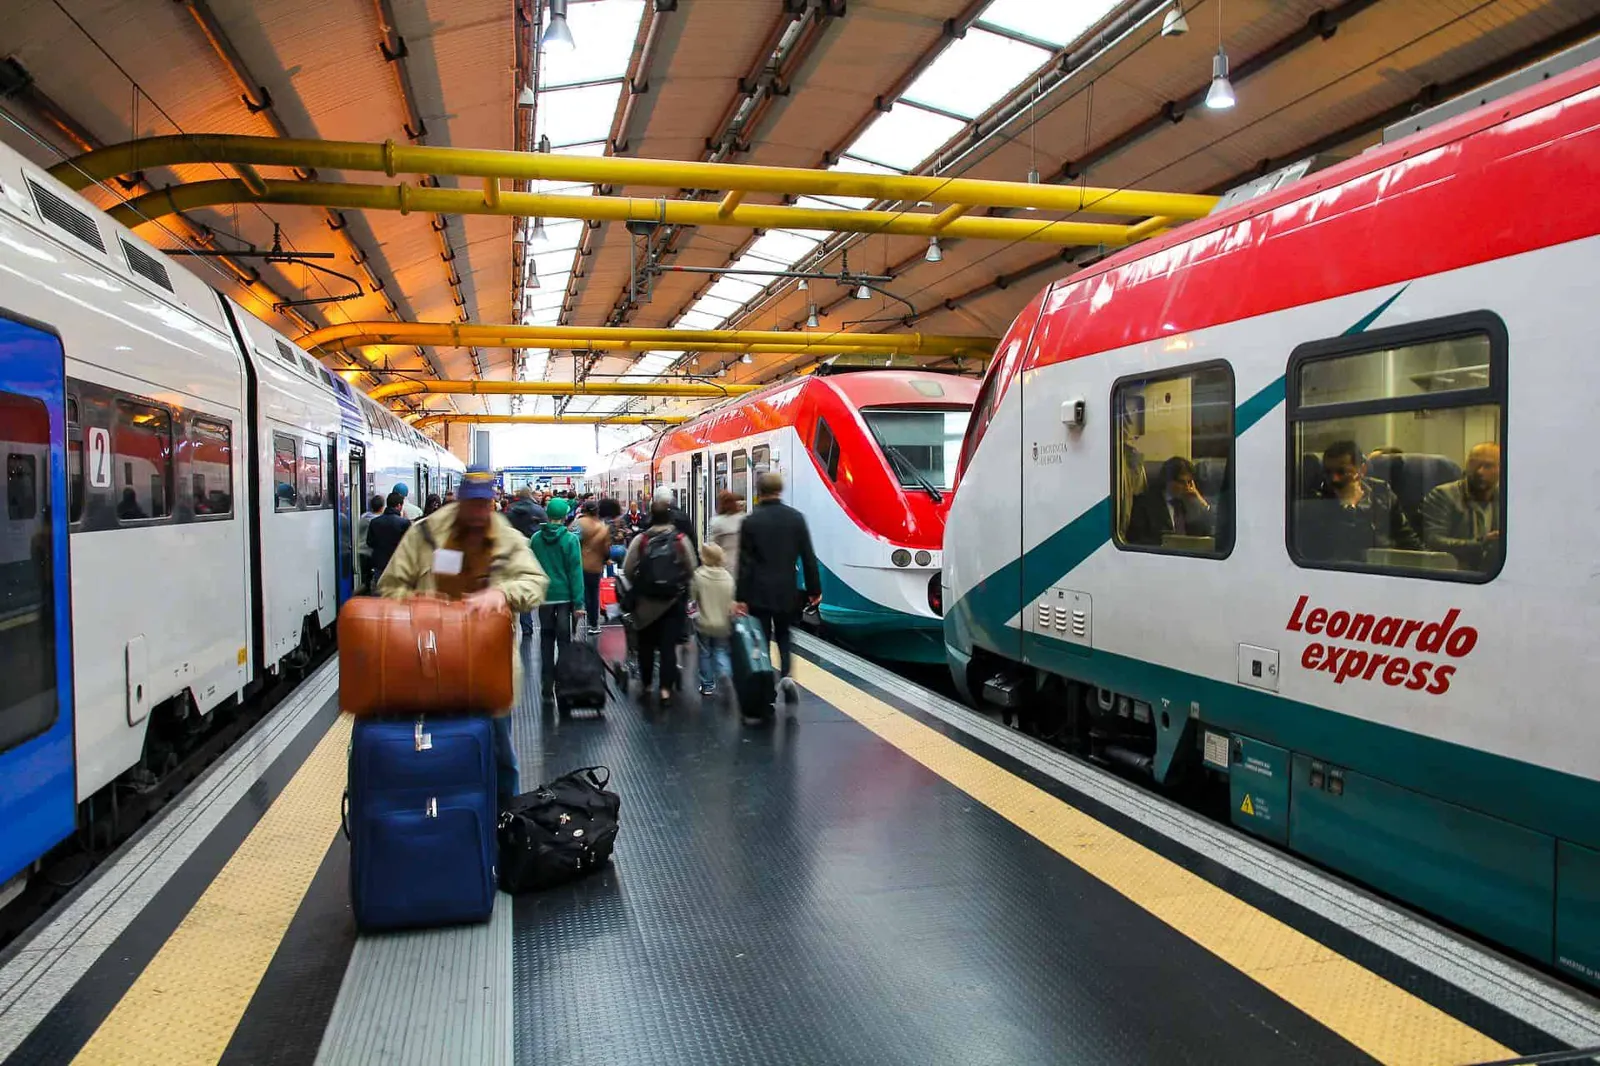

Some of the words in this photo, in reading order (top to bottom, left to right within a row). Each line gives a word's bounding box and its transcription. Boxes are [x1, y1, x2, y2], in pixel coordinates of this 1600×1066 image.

[95, 432, 106, 484] 2
[1286, 595, 1478, 657] Leonardo
[1301, 643, 1456, 695] express
